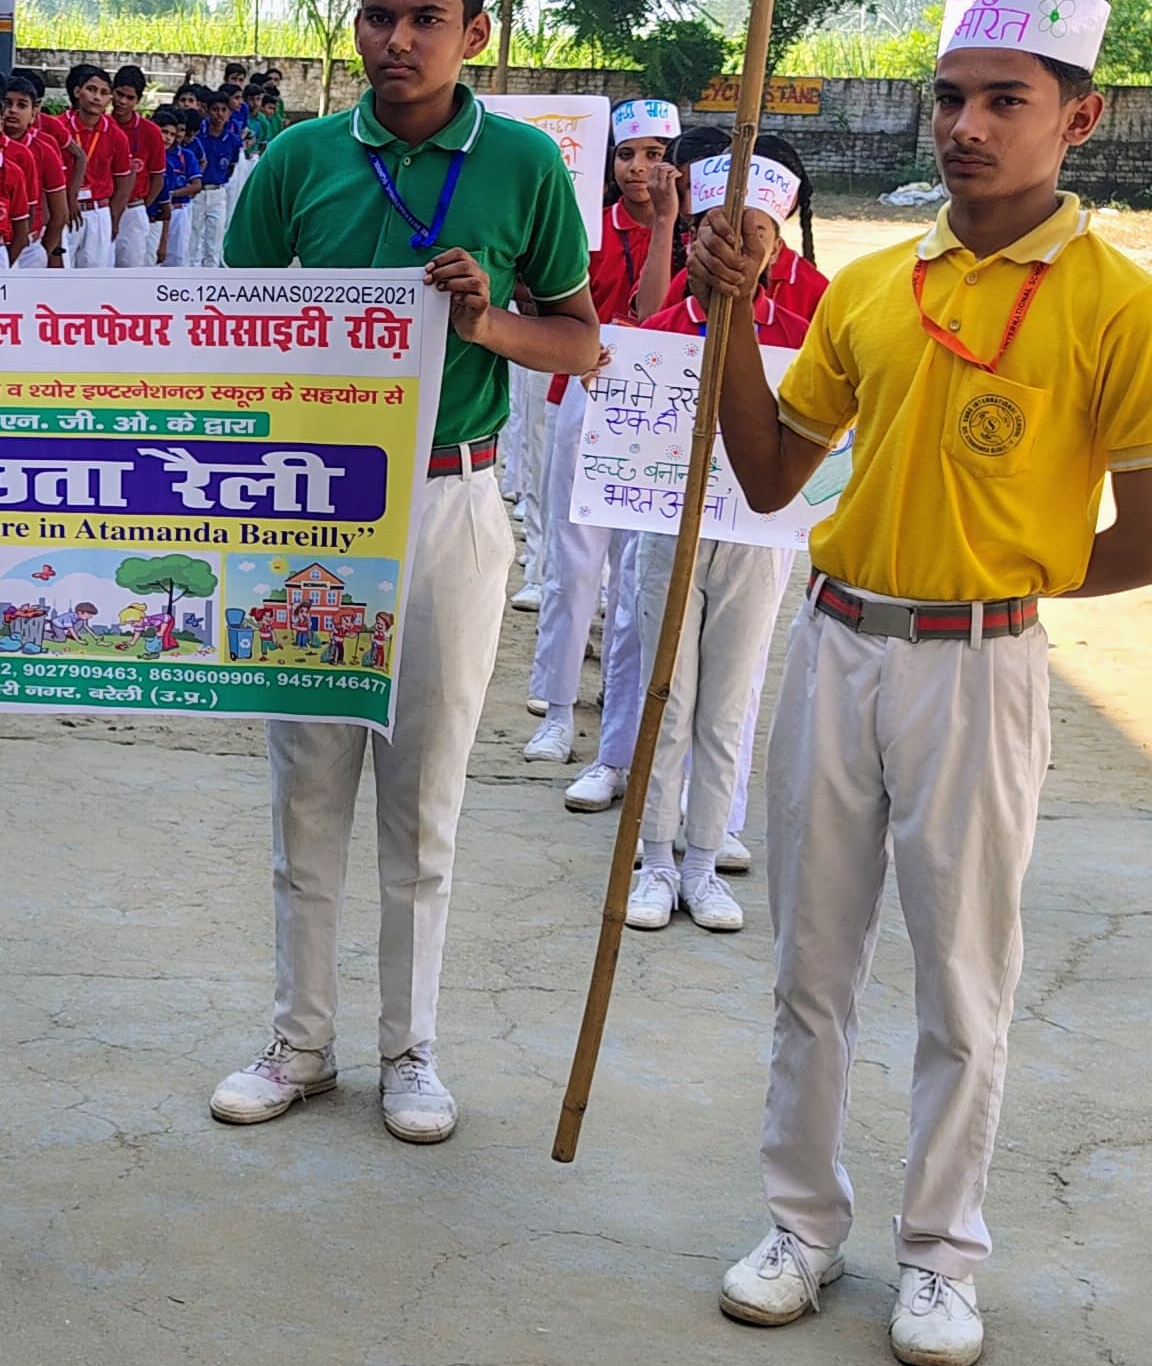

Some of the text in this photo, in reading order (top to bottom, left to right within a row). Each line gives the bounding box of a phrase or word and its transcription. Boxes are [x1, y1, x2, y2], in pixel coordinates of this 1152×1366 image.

[703, 157, 760, 176] Clen
[156, 284, 416, 305] Sec.12A-AANAS0222QE2021
[35, 304, 173, 347] वेलफेयर
[185, 305, 333, 353] सोसाइटी
[211, 385, 266, 408] स्कूल
[271, 381, 294, 402] के
[300, 383, 378, 405] सहयोग
[384, 385, 405, 405] से
[166, 412, 196, 433] के
[203, 416, 257, 436] द्वारा
[136, 446, 346, 514] रैली
[603, 484, 654, 514] भारत
[39, 518, 67, 539] in
[74, 519, 229, 544] Atamanda
[277, 672, 387, 695] 9457146477
